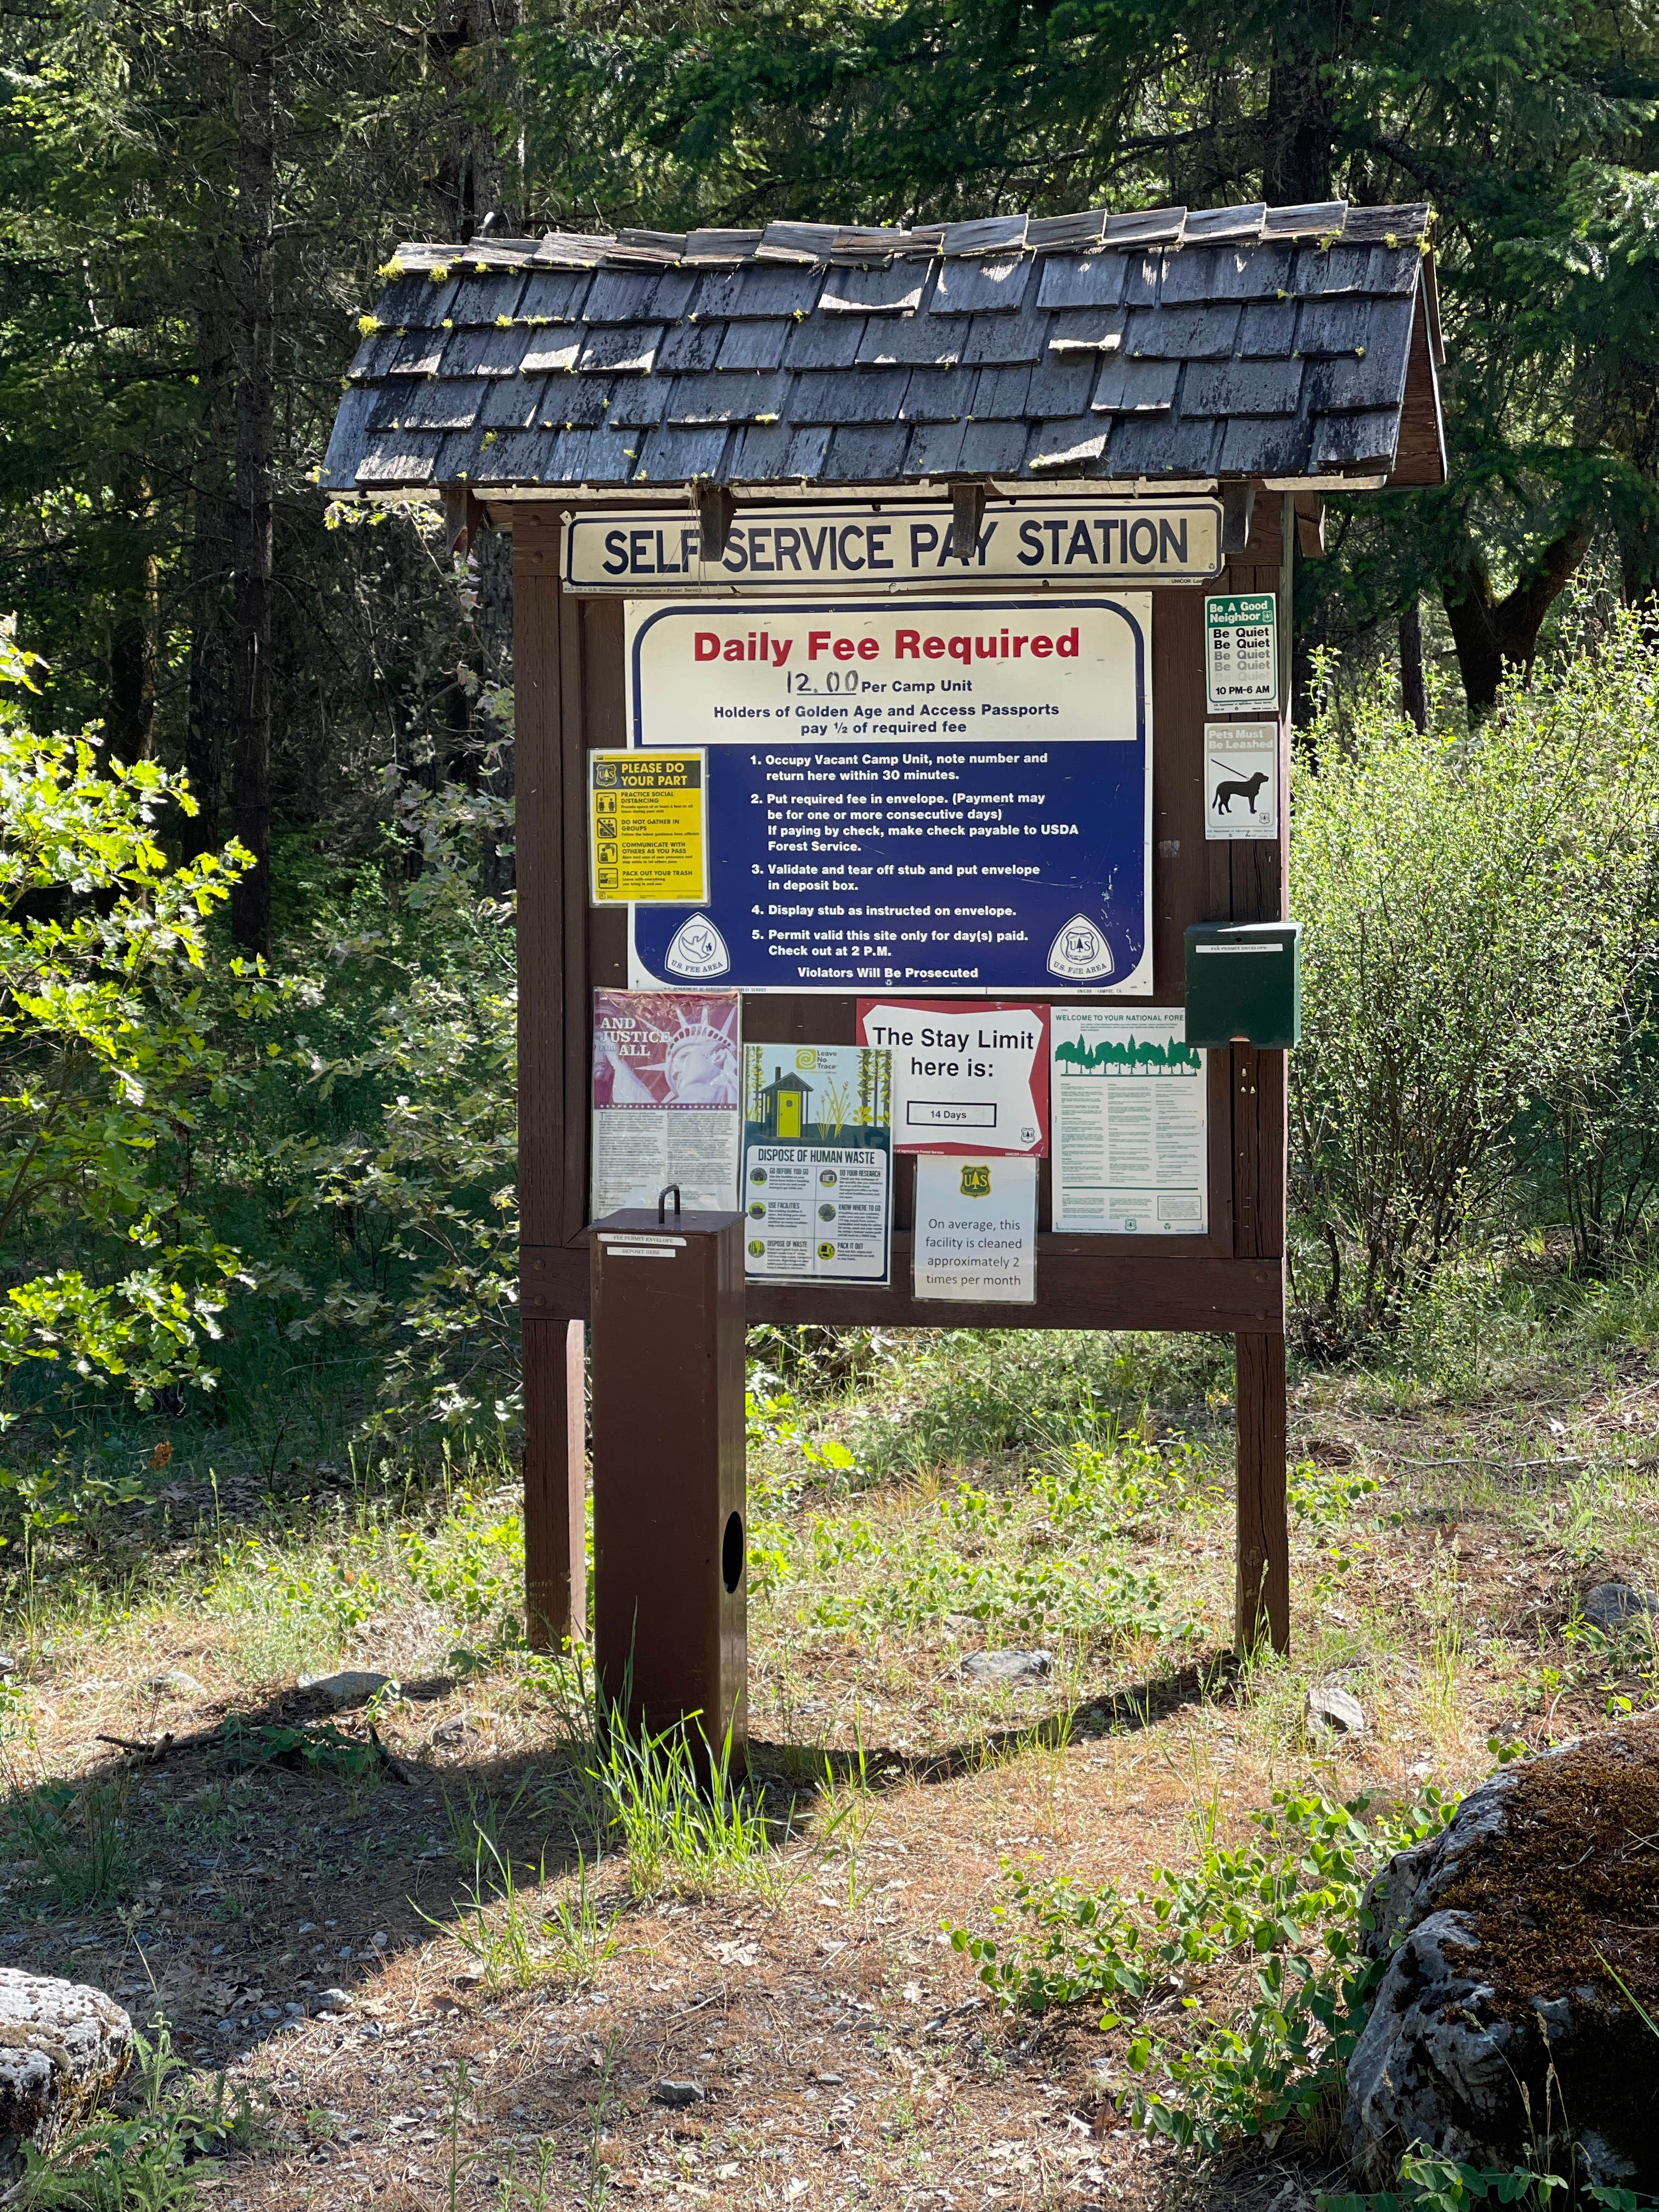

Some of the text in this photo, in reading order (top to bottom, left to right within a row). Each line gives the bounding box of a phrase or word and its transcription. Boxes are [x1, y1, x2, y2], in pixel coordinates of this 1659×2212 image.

[602, 529, 700, 574] SELF
[722, 524, 893, 573] SERVICE
[1017, 517, 1188, 566] STATION
[1210, 600, 1267, 612] Be A Good
[1210, 612, 1260, 623] Neighbor
[1214, 627, 1268, 638] Be Quiet
[695, 628, 1079, 666] Daily Fee Required
[1214, 638, 1269, 649] Be Quiet
[1214, 649, 1269, 660] Be Quiet
[1215, 660, 1269, 671] Be Quiet
[787, 670, 972, 693] 12.00 Per Camp Unit
[1216, 686, 1226, 695] 10
[1229, 686, 1252, 694] PM-6
[714, 704, 1059, 719] Holders of Golden Age and Access Passports
[801, 725, 827, 736] pay
[853, 722, 867, 733] of
[873, 721, 936, 735] required
[942, 721, 966, 732] fee
[1209, 730, 1263, 738] Pets Must
[1209, 740, 1273, 748] Be Leashed
[751, 753, 1047, 766] 1. Occupy Vacant Camp Unit, note number and
[622, 763, 684, 773] PLEASE DO
[621, 775, 687, 786] YOUR PART
[766, 770, 958, 780] return here within 30 minutes.
[751, 793, 1045, 805] 2. Put required fee in envelope. (Payment may
[768, 841, 861, 851] Forest Service.
[752, 929, 1028, 942] 5. Permit valid this site only for day(s) paid.
[769, 945, 891, 956] Check out at 2 P.M.
[798, 967, 978, 978] Violators Will Be Prosecuted
[1086, 963, 1107, 974] AREA
[600, 1018, 636, 1029] AND
[600, 1031, 671, 1043] JUSTICE
[872, 1027, 1033, 1052] The Stay Limit
[618, 1045, 650, 1057] ALL
[912, 1057, 992, 1076] here is:
[944, 1110, 966, 1120] Days
[758, 1148, 874, 1164] DISPOSE OF HUMAN WASTE
[929, 1218, 1019, 1231] On average, this
[926, 1237, 1022, 1249] facility is cleaned
[928, 1256, 1019, 1268] approximately 2
[926, 1274, 1020, 1286] times per month
